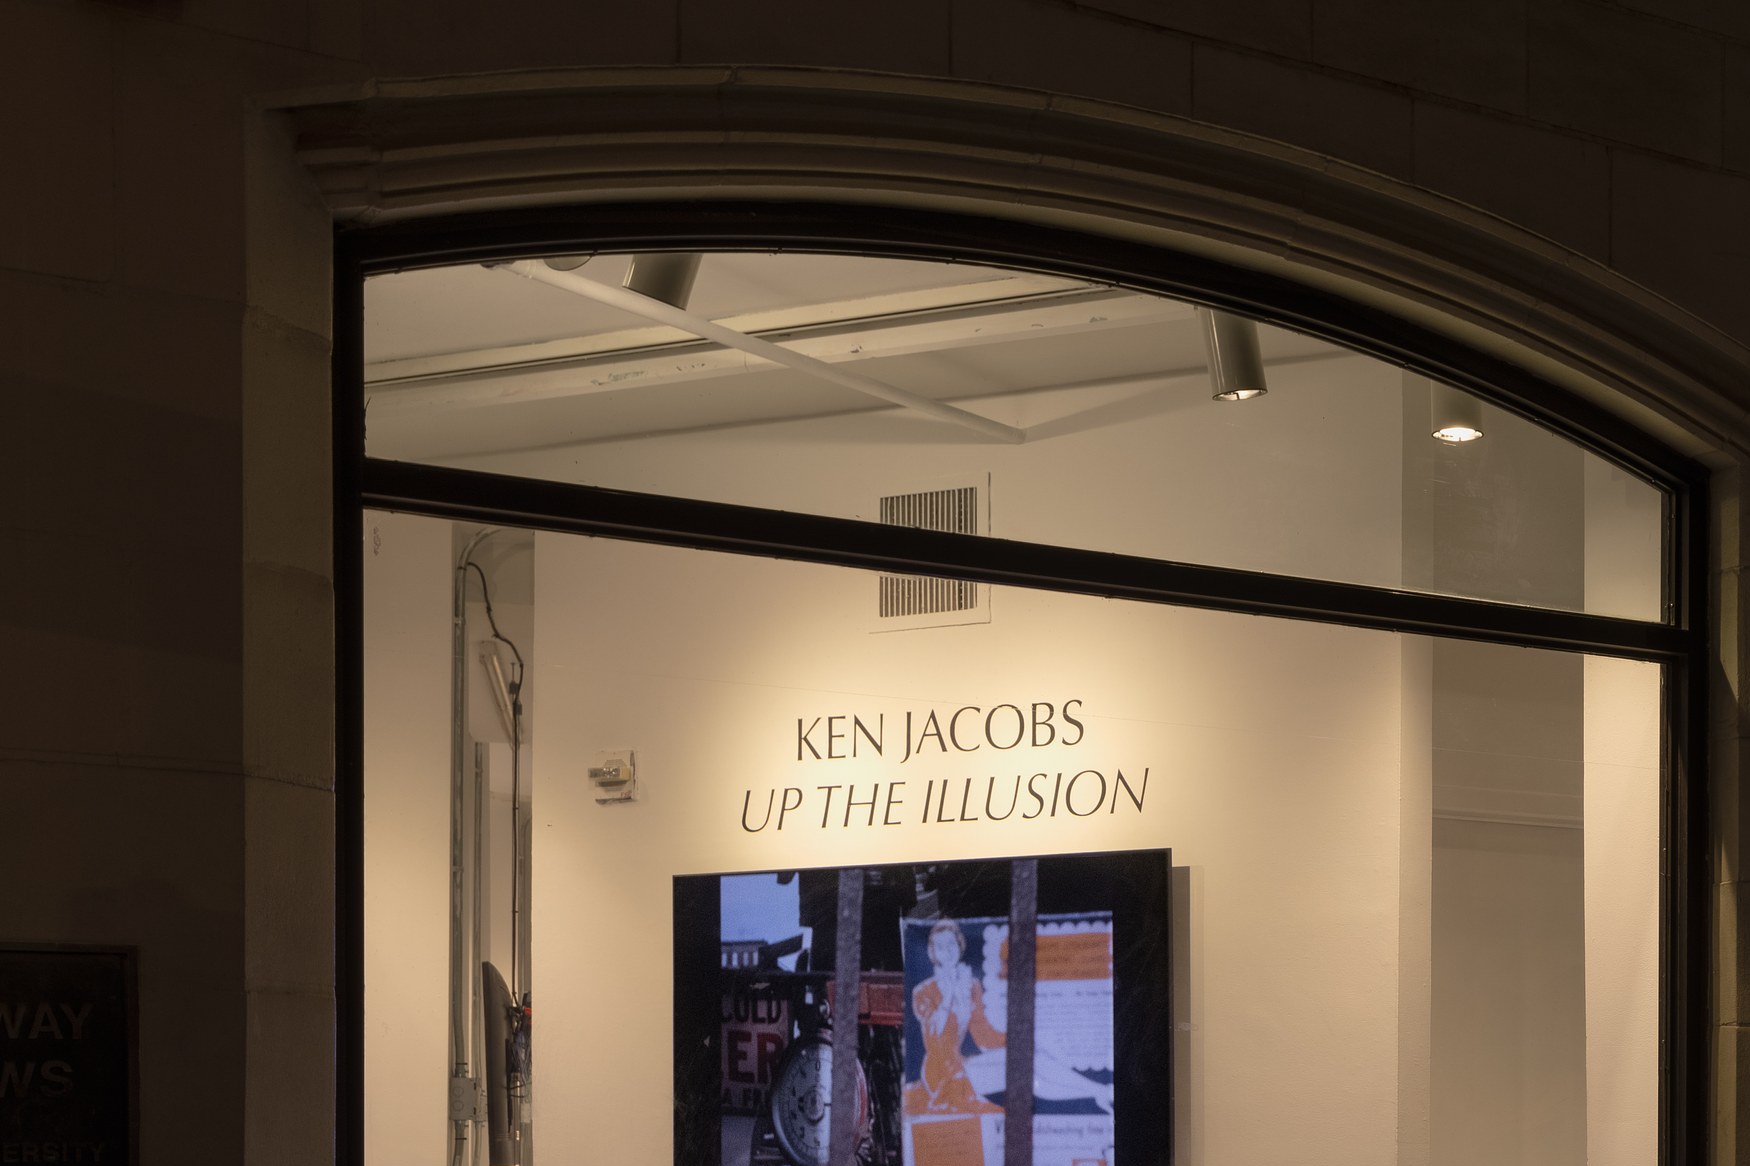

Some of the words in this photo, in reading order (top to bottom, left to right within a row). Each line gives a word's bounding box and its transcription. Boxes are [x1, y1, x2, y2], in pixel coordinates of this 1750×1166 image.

[797, 713, 884, 761] KEN
[900, 699, 1086, 764] JACOBS
[741, 787, 803, 833] UP
[817, 781, 906, 829] THE
[922, 767, 1149, 824] ILLUSION
